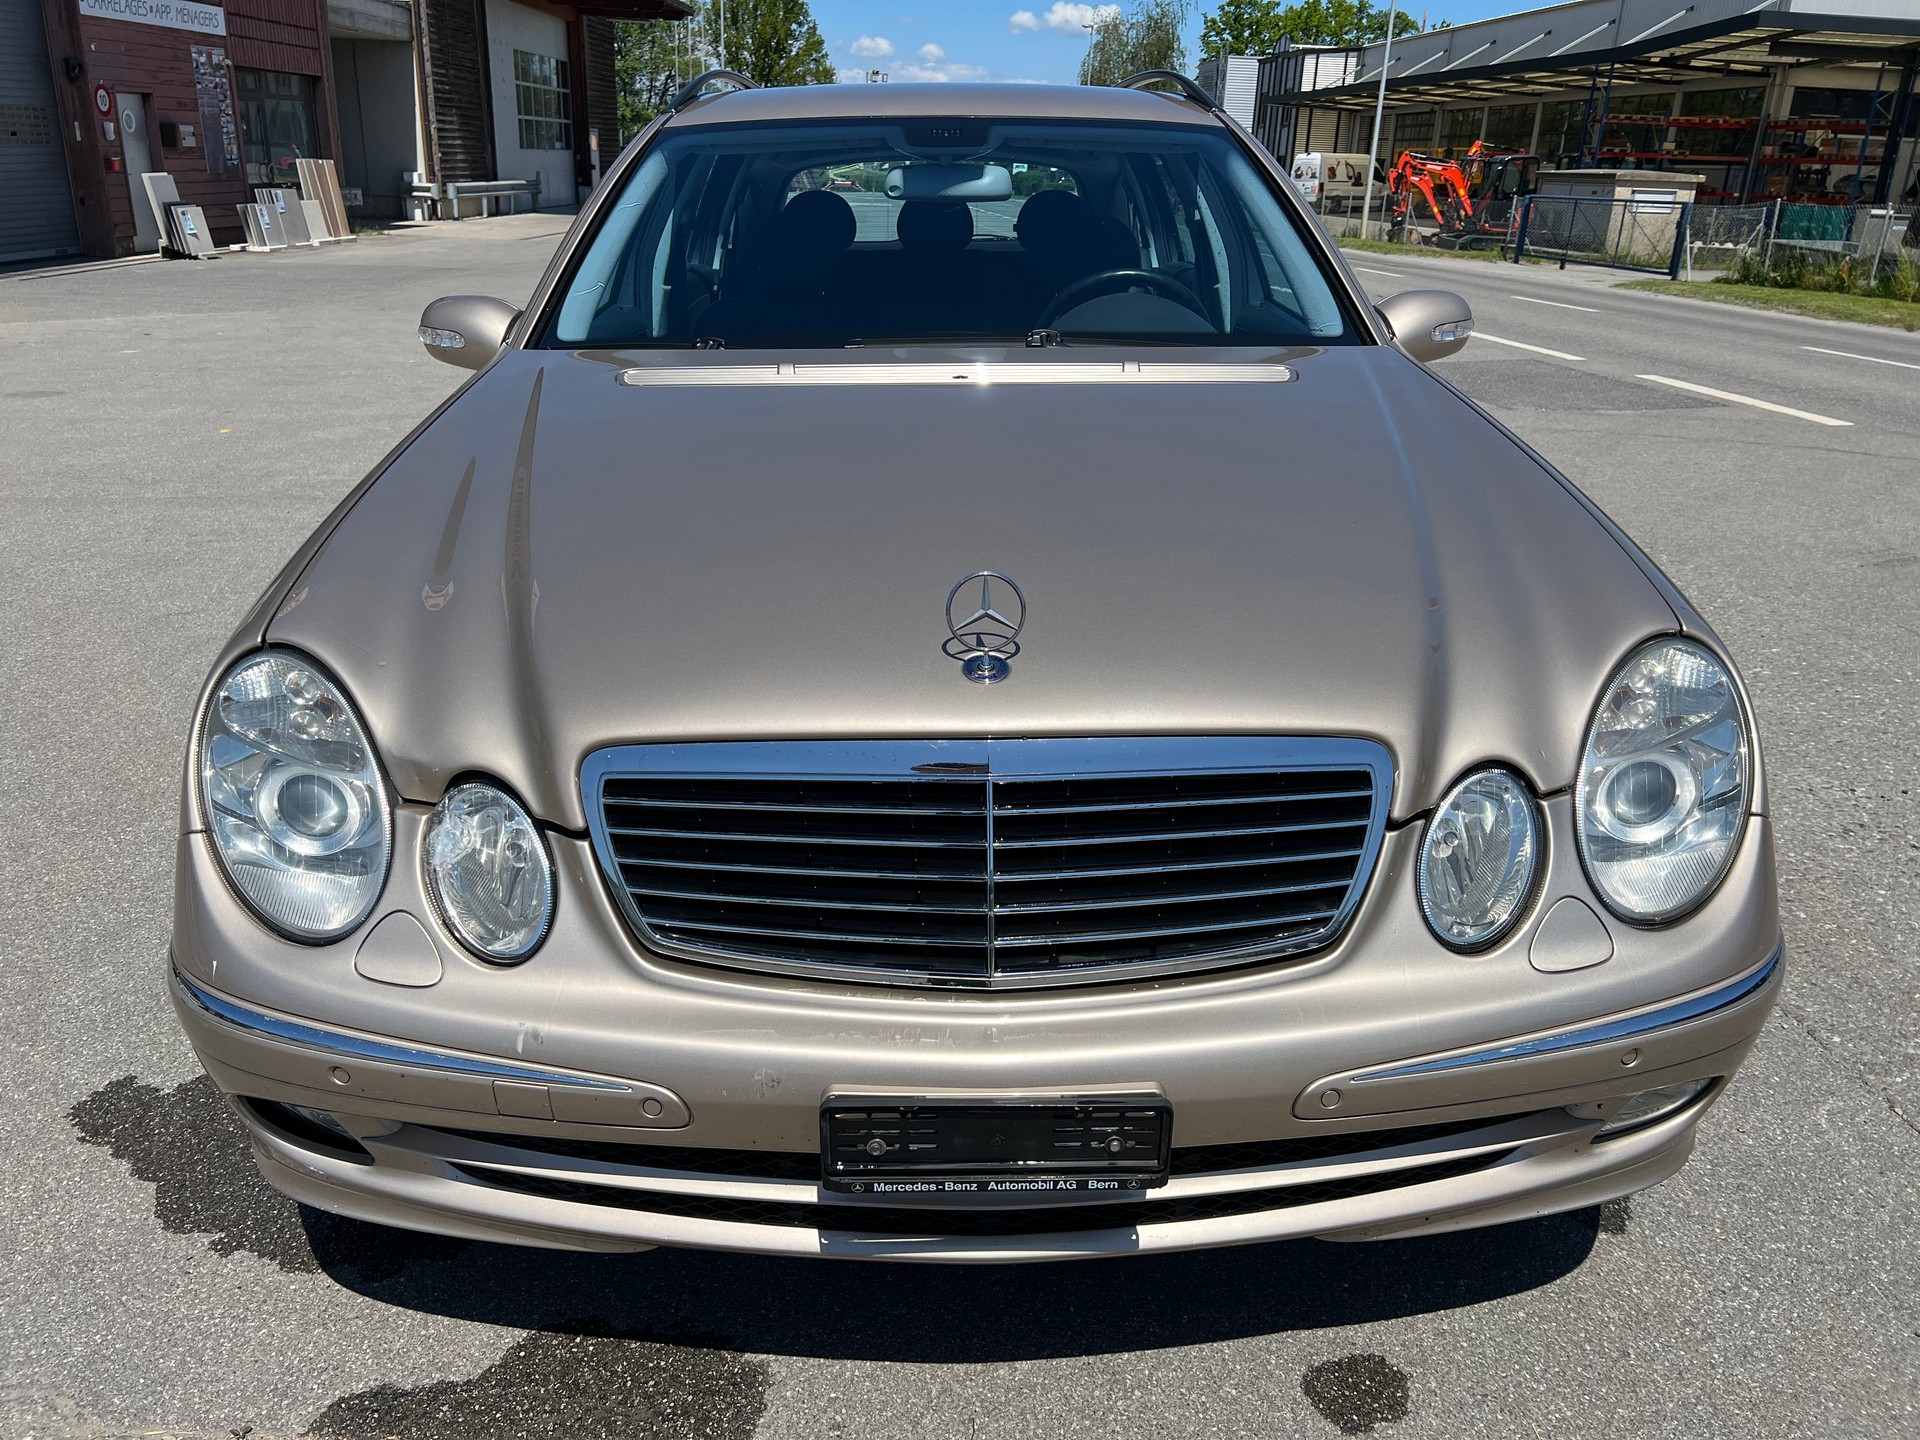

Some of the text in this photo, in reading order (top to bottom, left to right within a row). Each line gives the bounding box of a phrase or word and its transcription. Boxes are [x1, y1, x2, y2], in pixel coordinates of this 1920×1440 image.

[87, 0, 220, 29] CARRELAGES APP. MÉNAGERS
[99, 94, 108, 107] 10
[873, 1179, 1119, 1193] Mercedes-Benz Automobil AG Bern
